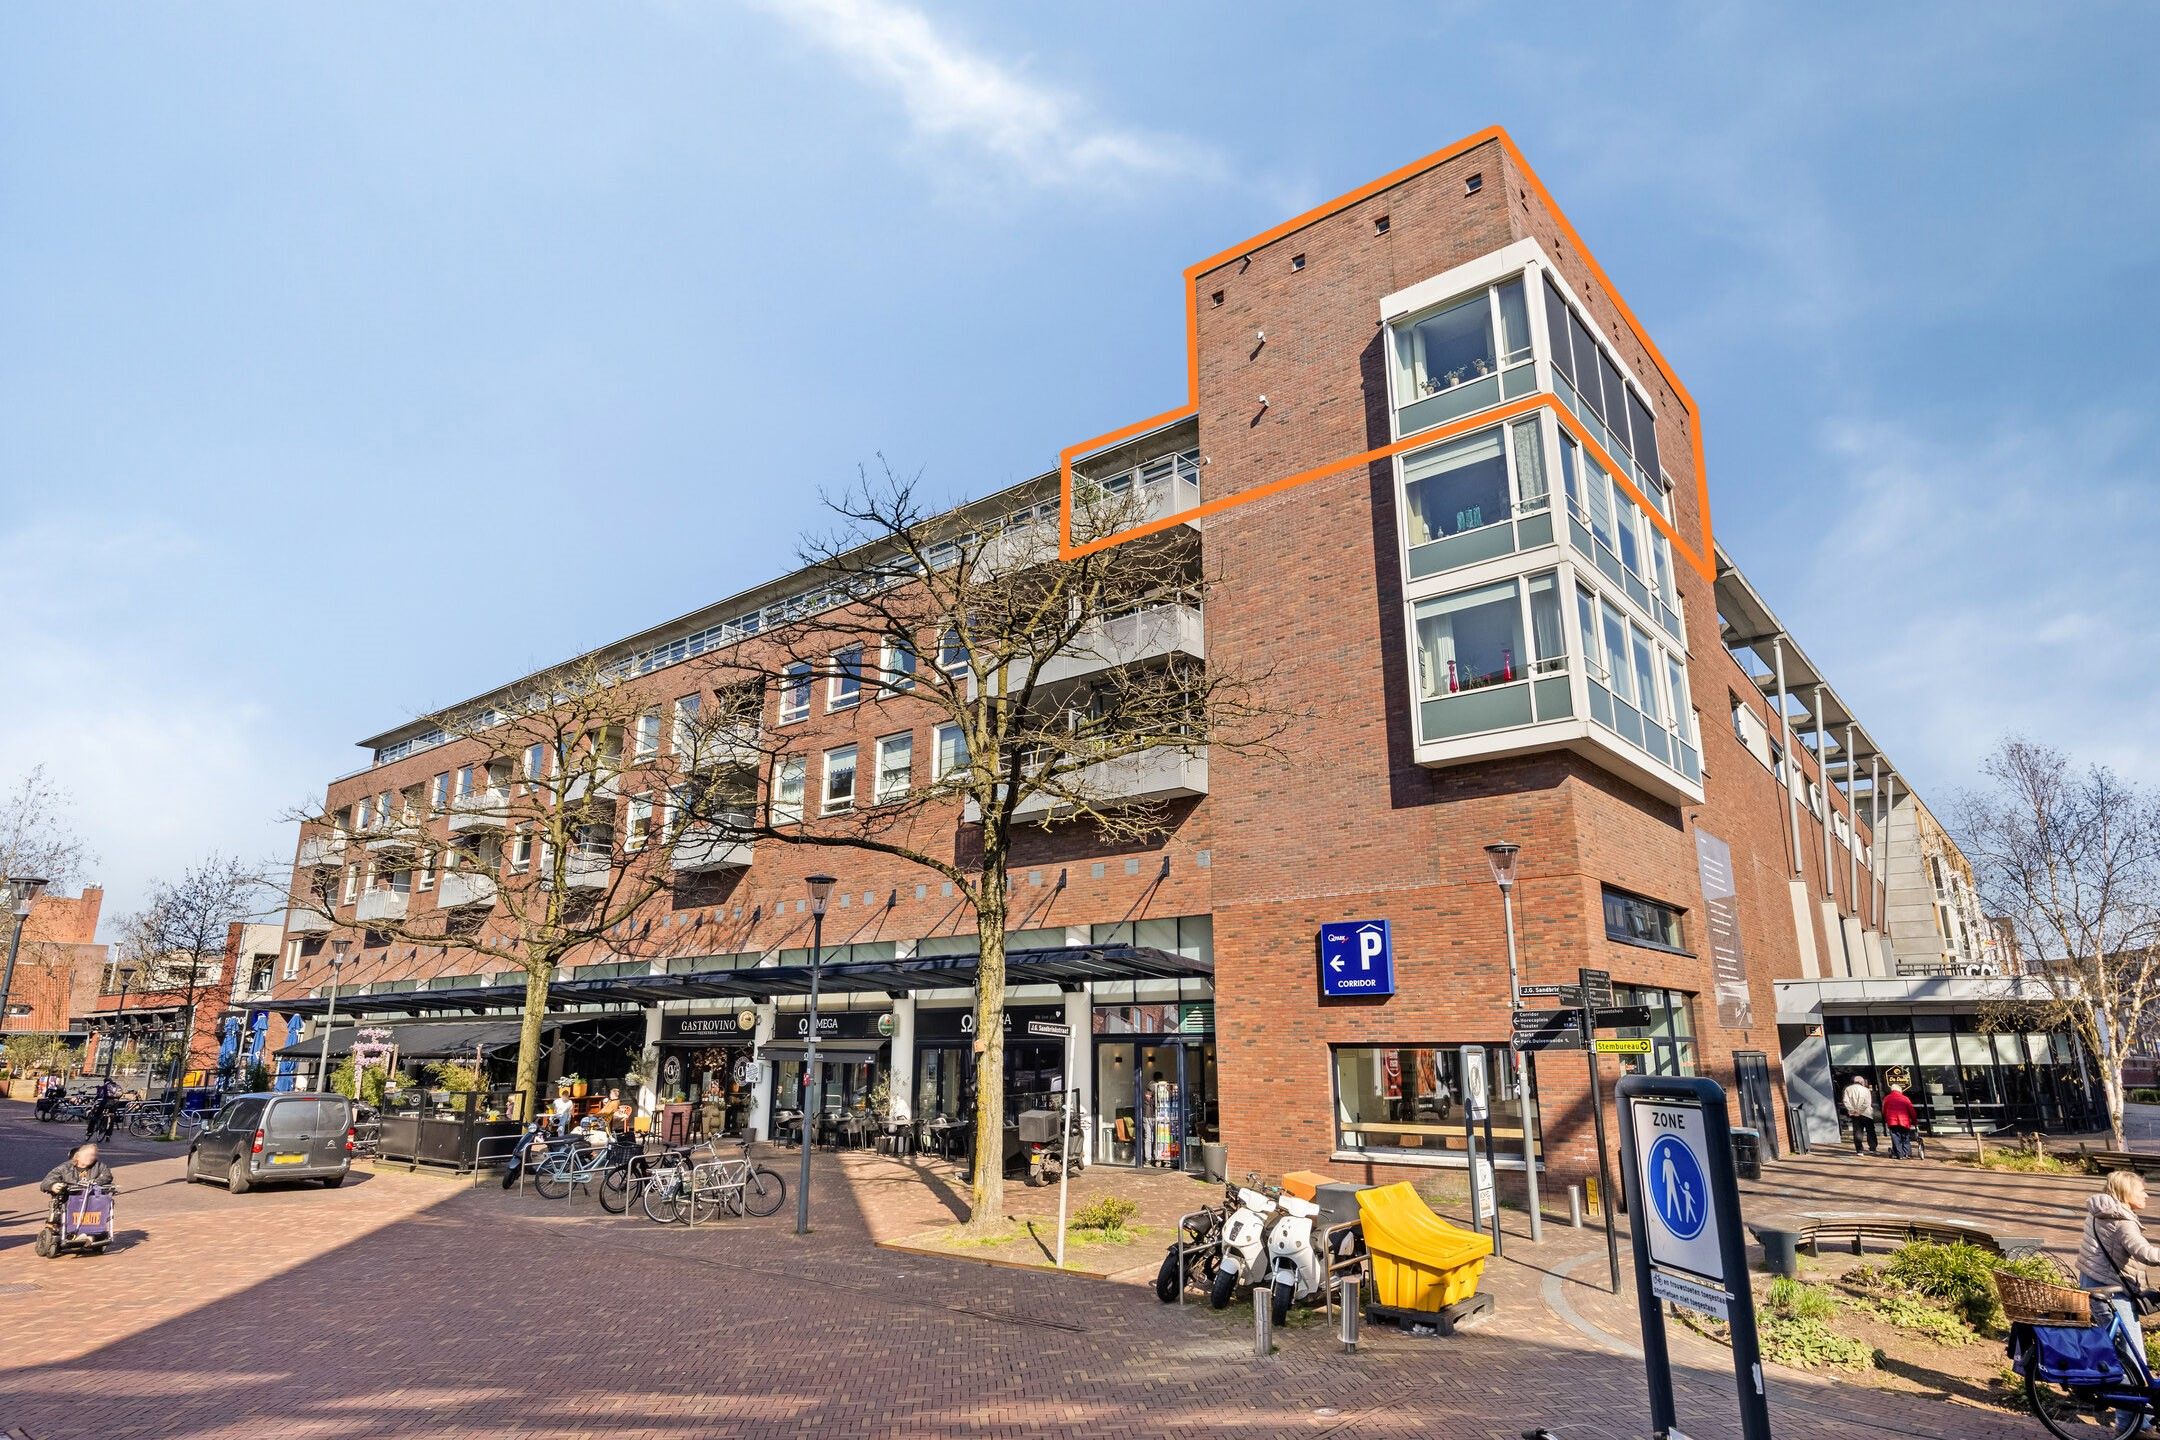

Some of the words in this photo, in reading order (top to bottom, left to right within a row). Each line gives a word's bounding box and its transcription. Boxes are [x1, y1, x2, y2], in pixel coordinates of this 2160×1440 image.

[1360, 932, 1382, 970] P
[1338, 979, 1376, 988] CORRIDOR
[681, 1019, 736, 1031] GASTROVINO
[815, 1018, 839, 1028] MEGA
[1597, 1042, 1640, 1050] Stembureau
[1652, 1111, 1686, 1129] ZONE
